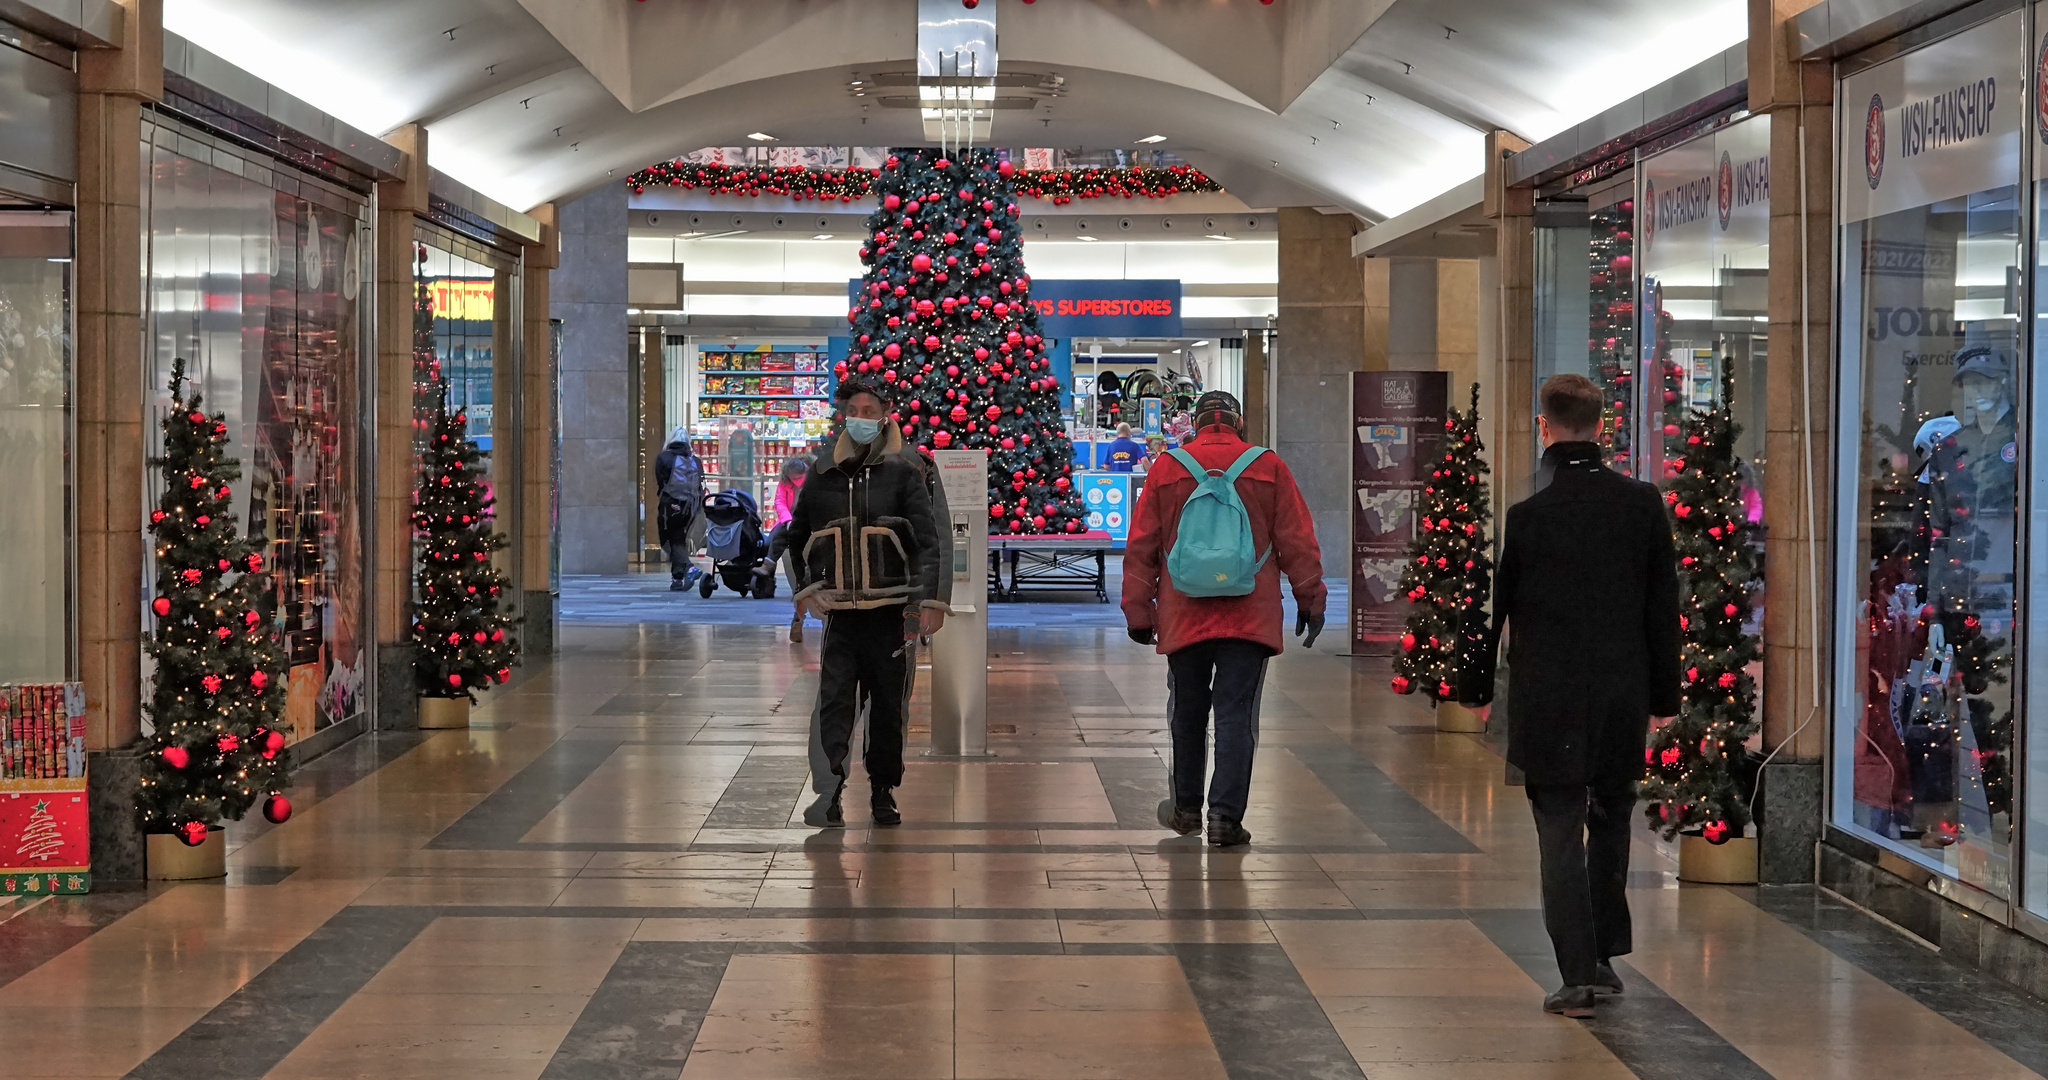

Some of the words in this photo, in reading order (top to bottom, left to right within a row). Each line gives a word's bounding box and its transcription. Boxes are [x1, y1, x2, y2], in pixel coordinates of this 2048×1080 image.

[1901, 77, 1997, 159] WSV-FANSHOP
[1658, 176, 1711, 232] WSV-FANSHOP
[1736, 156, 1770, 208] WSV-FA
[1027, 299, 1054, 316] YS
[1058, 299, 1172, 316] SUPERSTORES
[1902, 350, 1956, 367] Exercis
